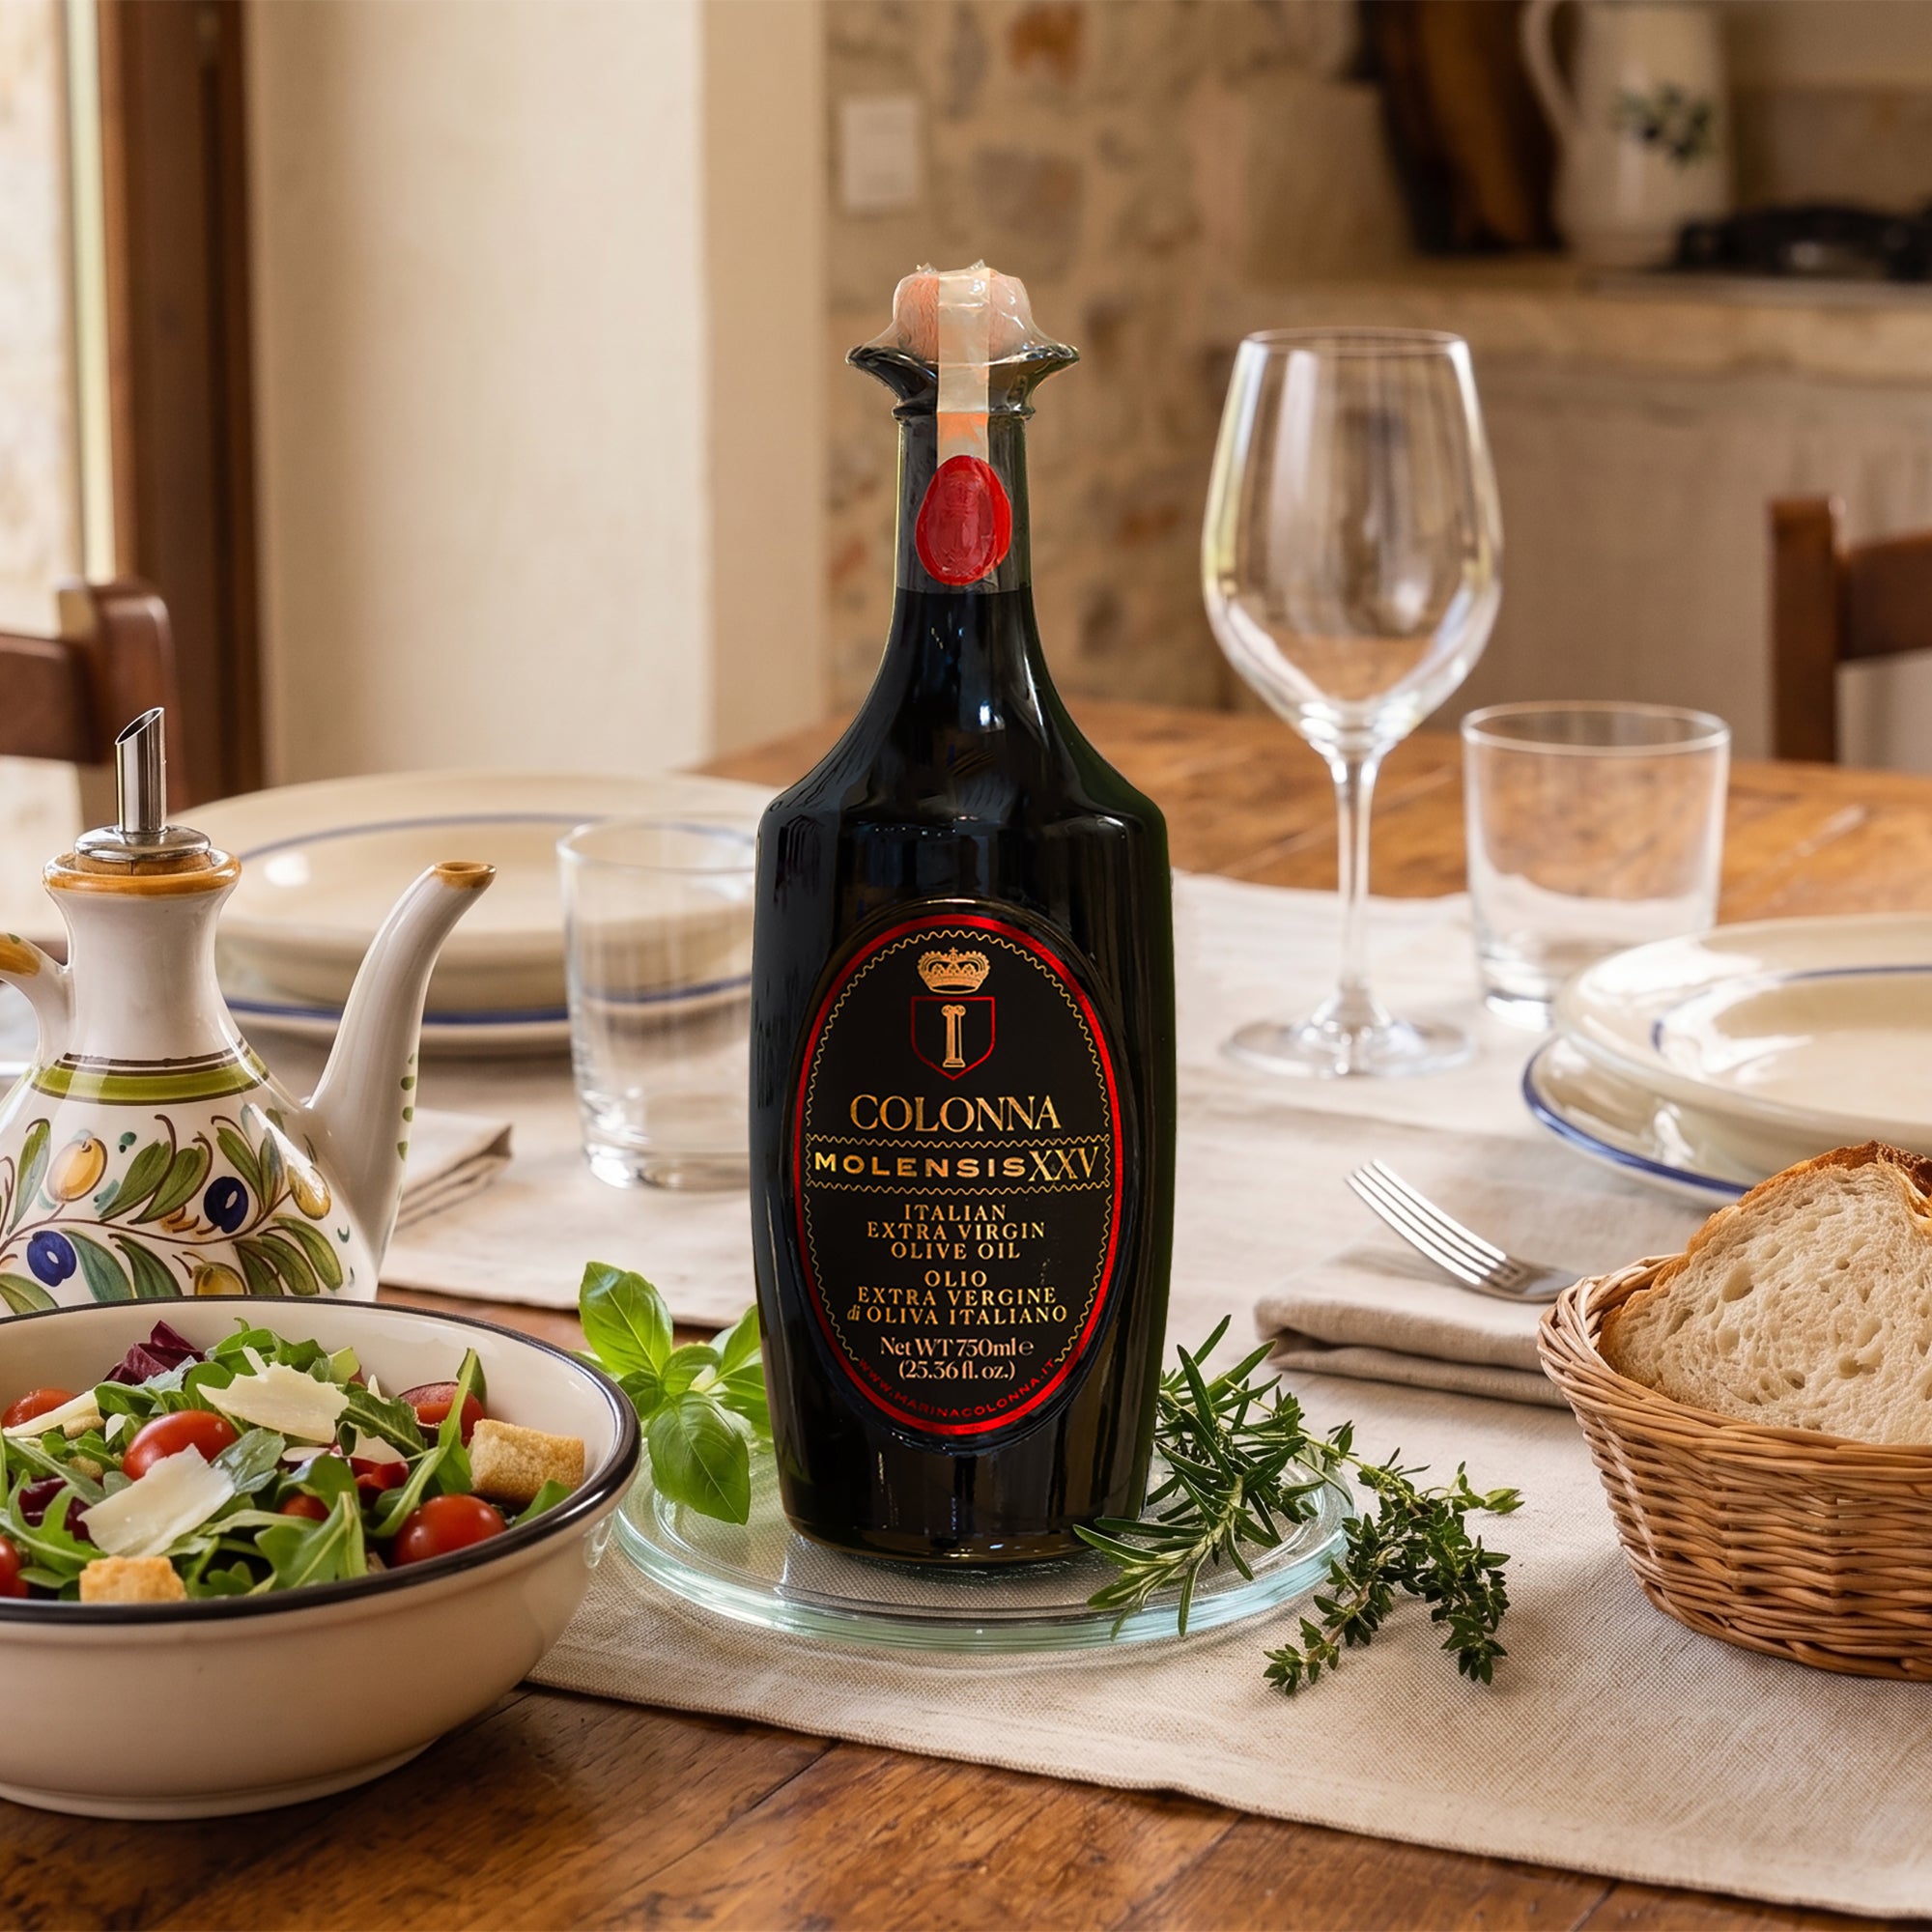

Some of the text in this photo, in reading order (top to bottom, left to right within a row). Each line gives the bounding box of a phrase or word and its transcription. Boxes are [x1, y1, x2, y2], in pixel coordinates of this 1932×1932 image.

[850, 1094, 1062, 1132] COLONNA
[814, 1146, 1099, 1182] MOLENSIS XXV
[904, 1204, 1007, 1222] ITALIAN
[867, 1222, 1045, 1240] EXTRA VIRGIN
[891, 1241, 1021, 1261] OLIVE OIL
[923, 1269, 987, 1288] OLIO
[857, 1286, 1056, 1306] EXTRA VERGINE
[846, 1304, 1067, 1324] di OLIVA ITALIANO
[880, 1336, 912, 1356] Net
[914, 1337, 953, 1357] WT
[898, 1359, 1016, 1380] (25.36 fl. oz.)
[858, 1356, 1056, 1419] WWW.MARINACOLONNA.IT
